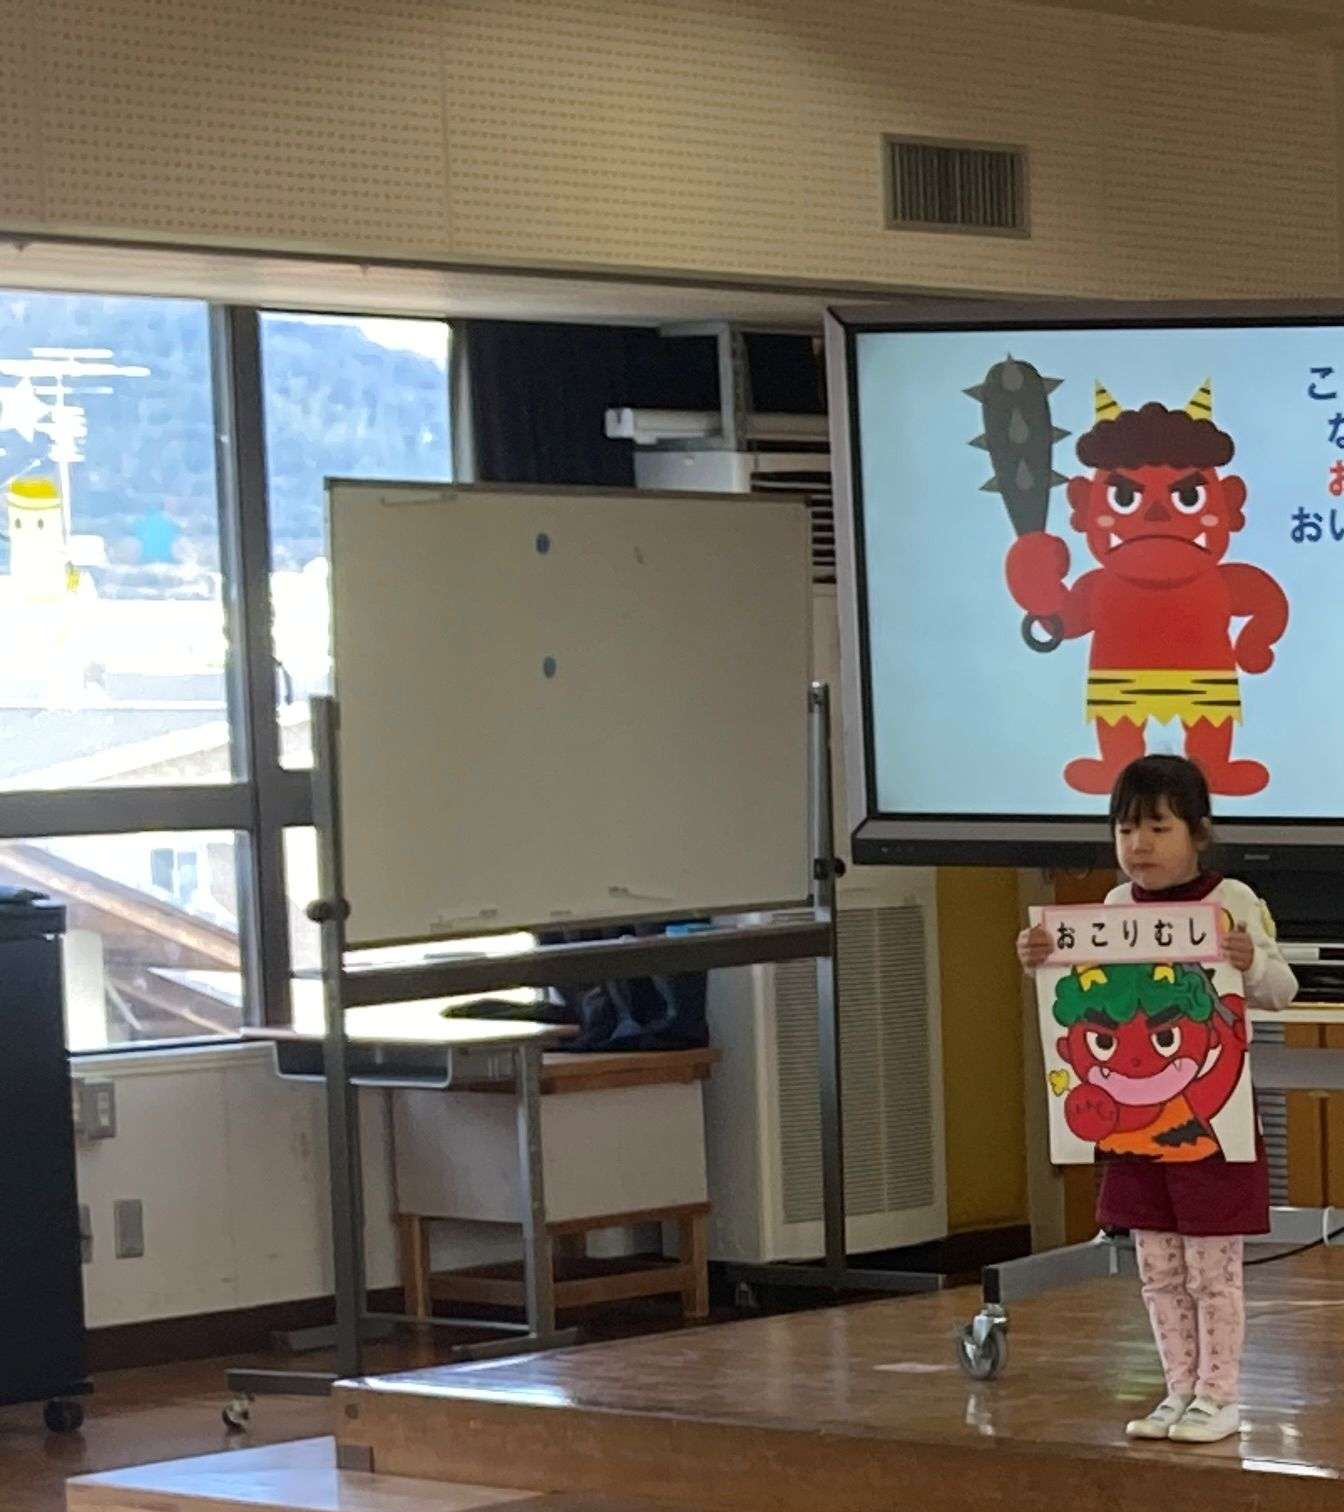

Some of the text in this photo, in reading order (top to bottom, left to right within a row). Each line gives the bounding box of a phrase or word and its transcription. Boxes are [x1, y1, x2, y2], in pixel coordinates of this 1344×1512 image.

[1056, 917, 1208, 950] おこりむし
